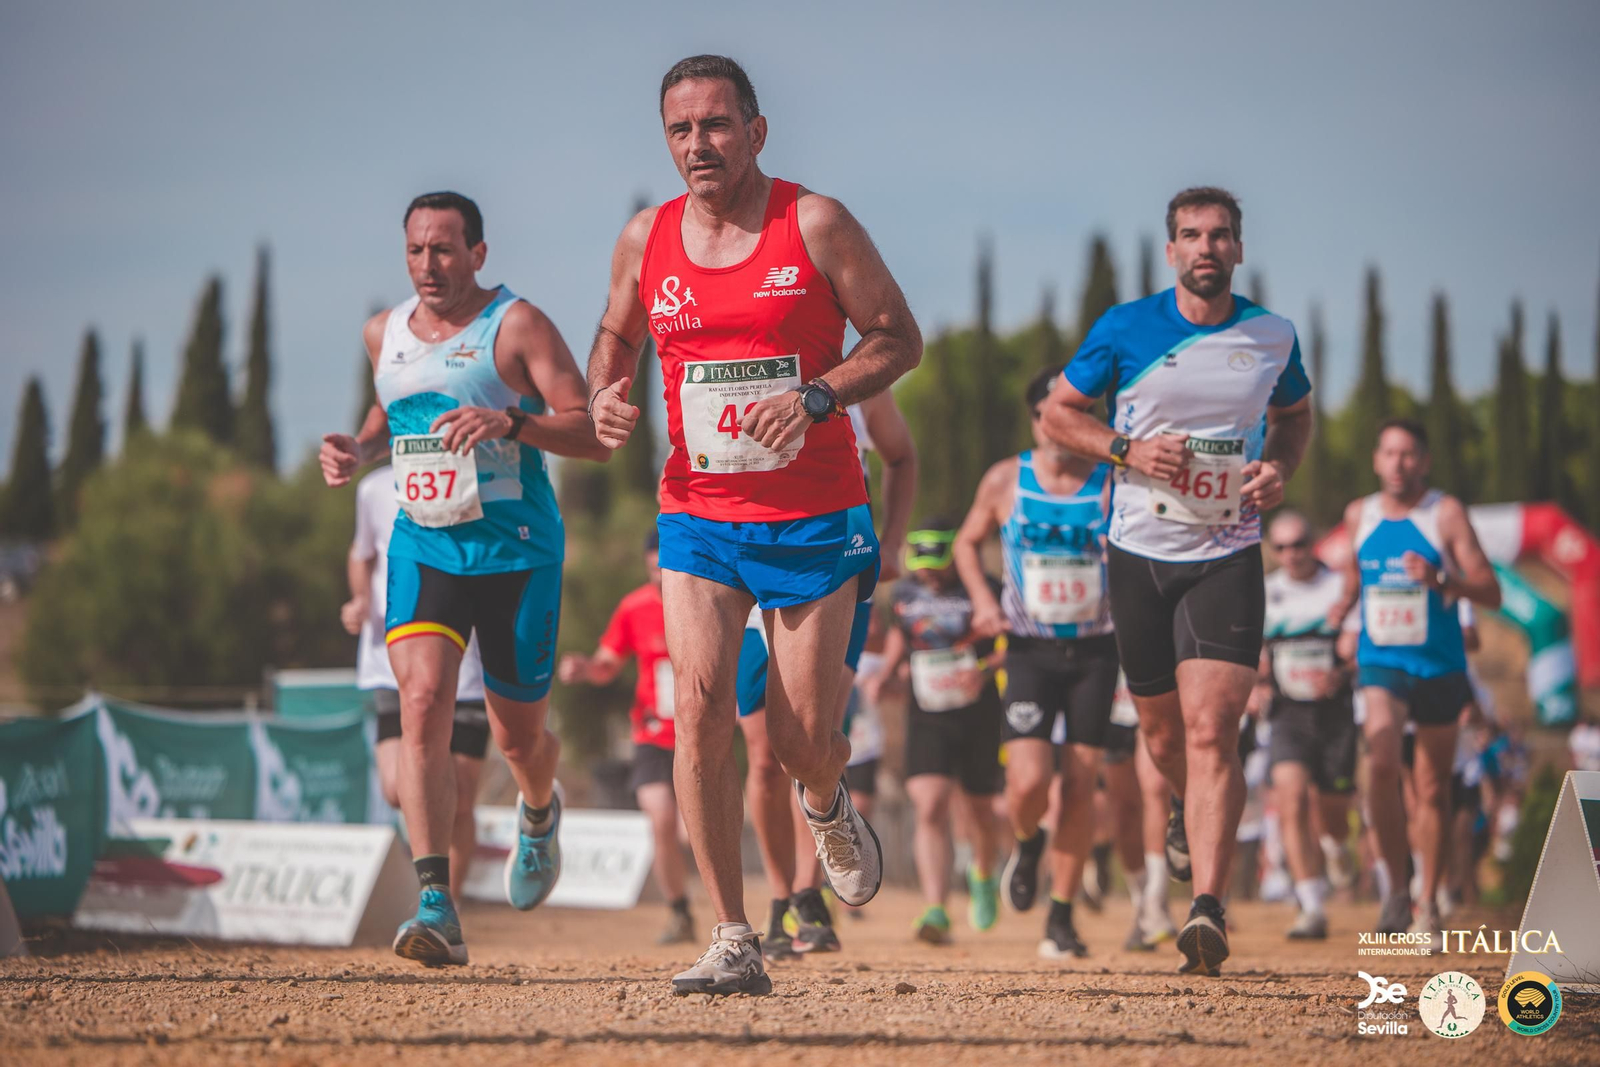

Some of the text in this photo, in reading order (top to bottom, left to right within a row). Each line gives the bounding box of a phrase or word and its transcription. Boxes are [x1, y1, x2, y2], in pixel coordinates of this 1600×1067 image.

[753, 288, 807, 298] new balance
[652, 313, 702, 334] Sevilla
[710, 364, 768, 379] ITÁLICA
[406, 470, 457, 501] 637
[1170, 468, 1229, 500] 461
[844, 546, 873, 558] VIATOR
